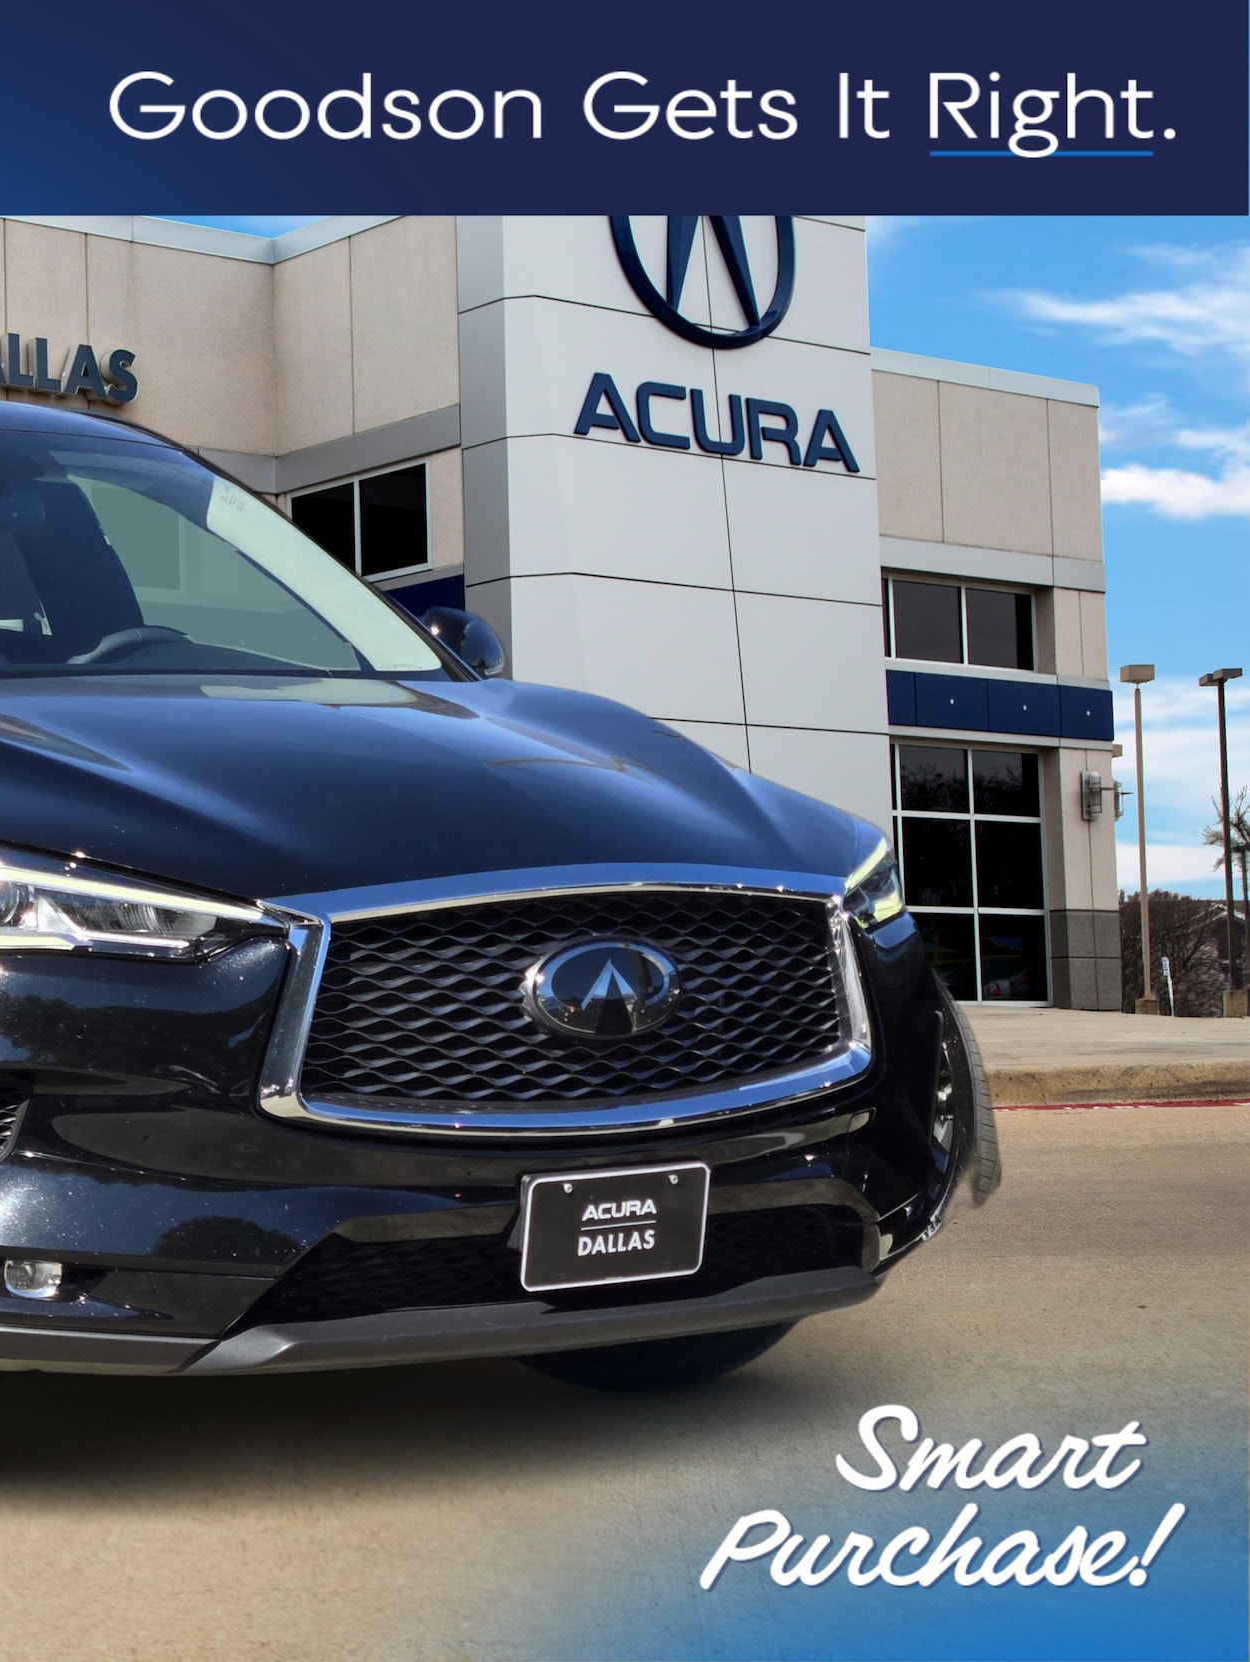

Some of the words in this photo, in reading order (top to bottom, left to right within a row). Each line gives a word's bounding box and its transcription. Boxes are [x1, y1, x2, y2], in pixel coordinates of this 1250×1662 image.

[573, 371, 861, 473] ACURA
[581, 1198, 657, 1222] ACURA
[577, 1229, 656, 1257] DALLAS
